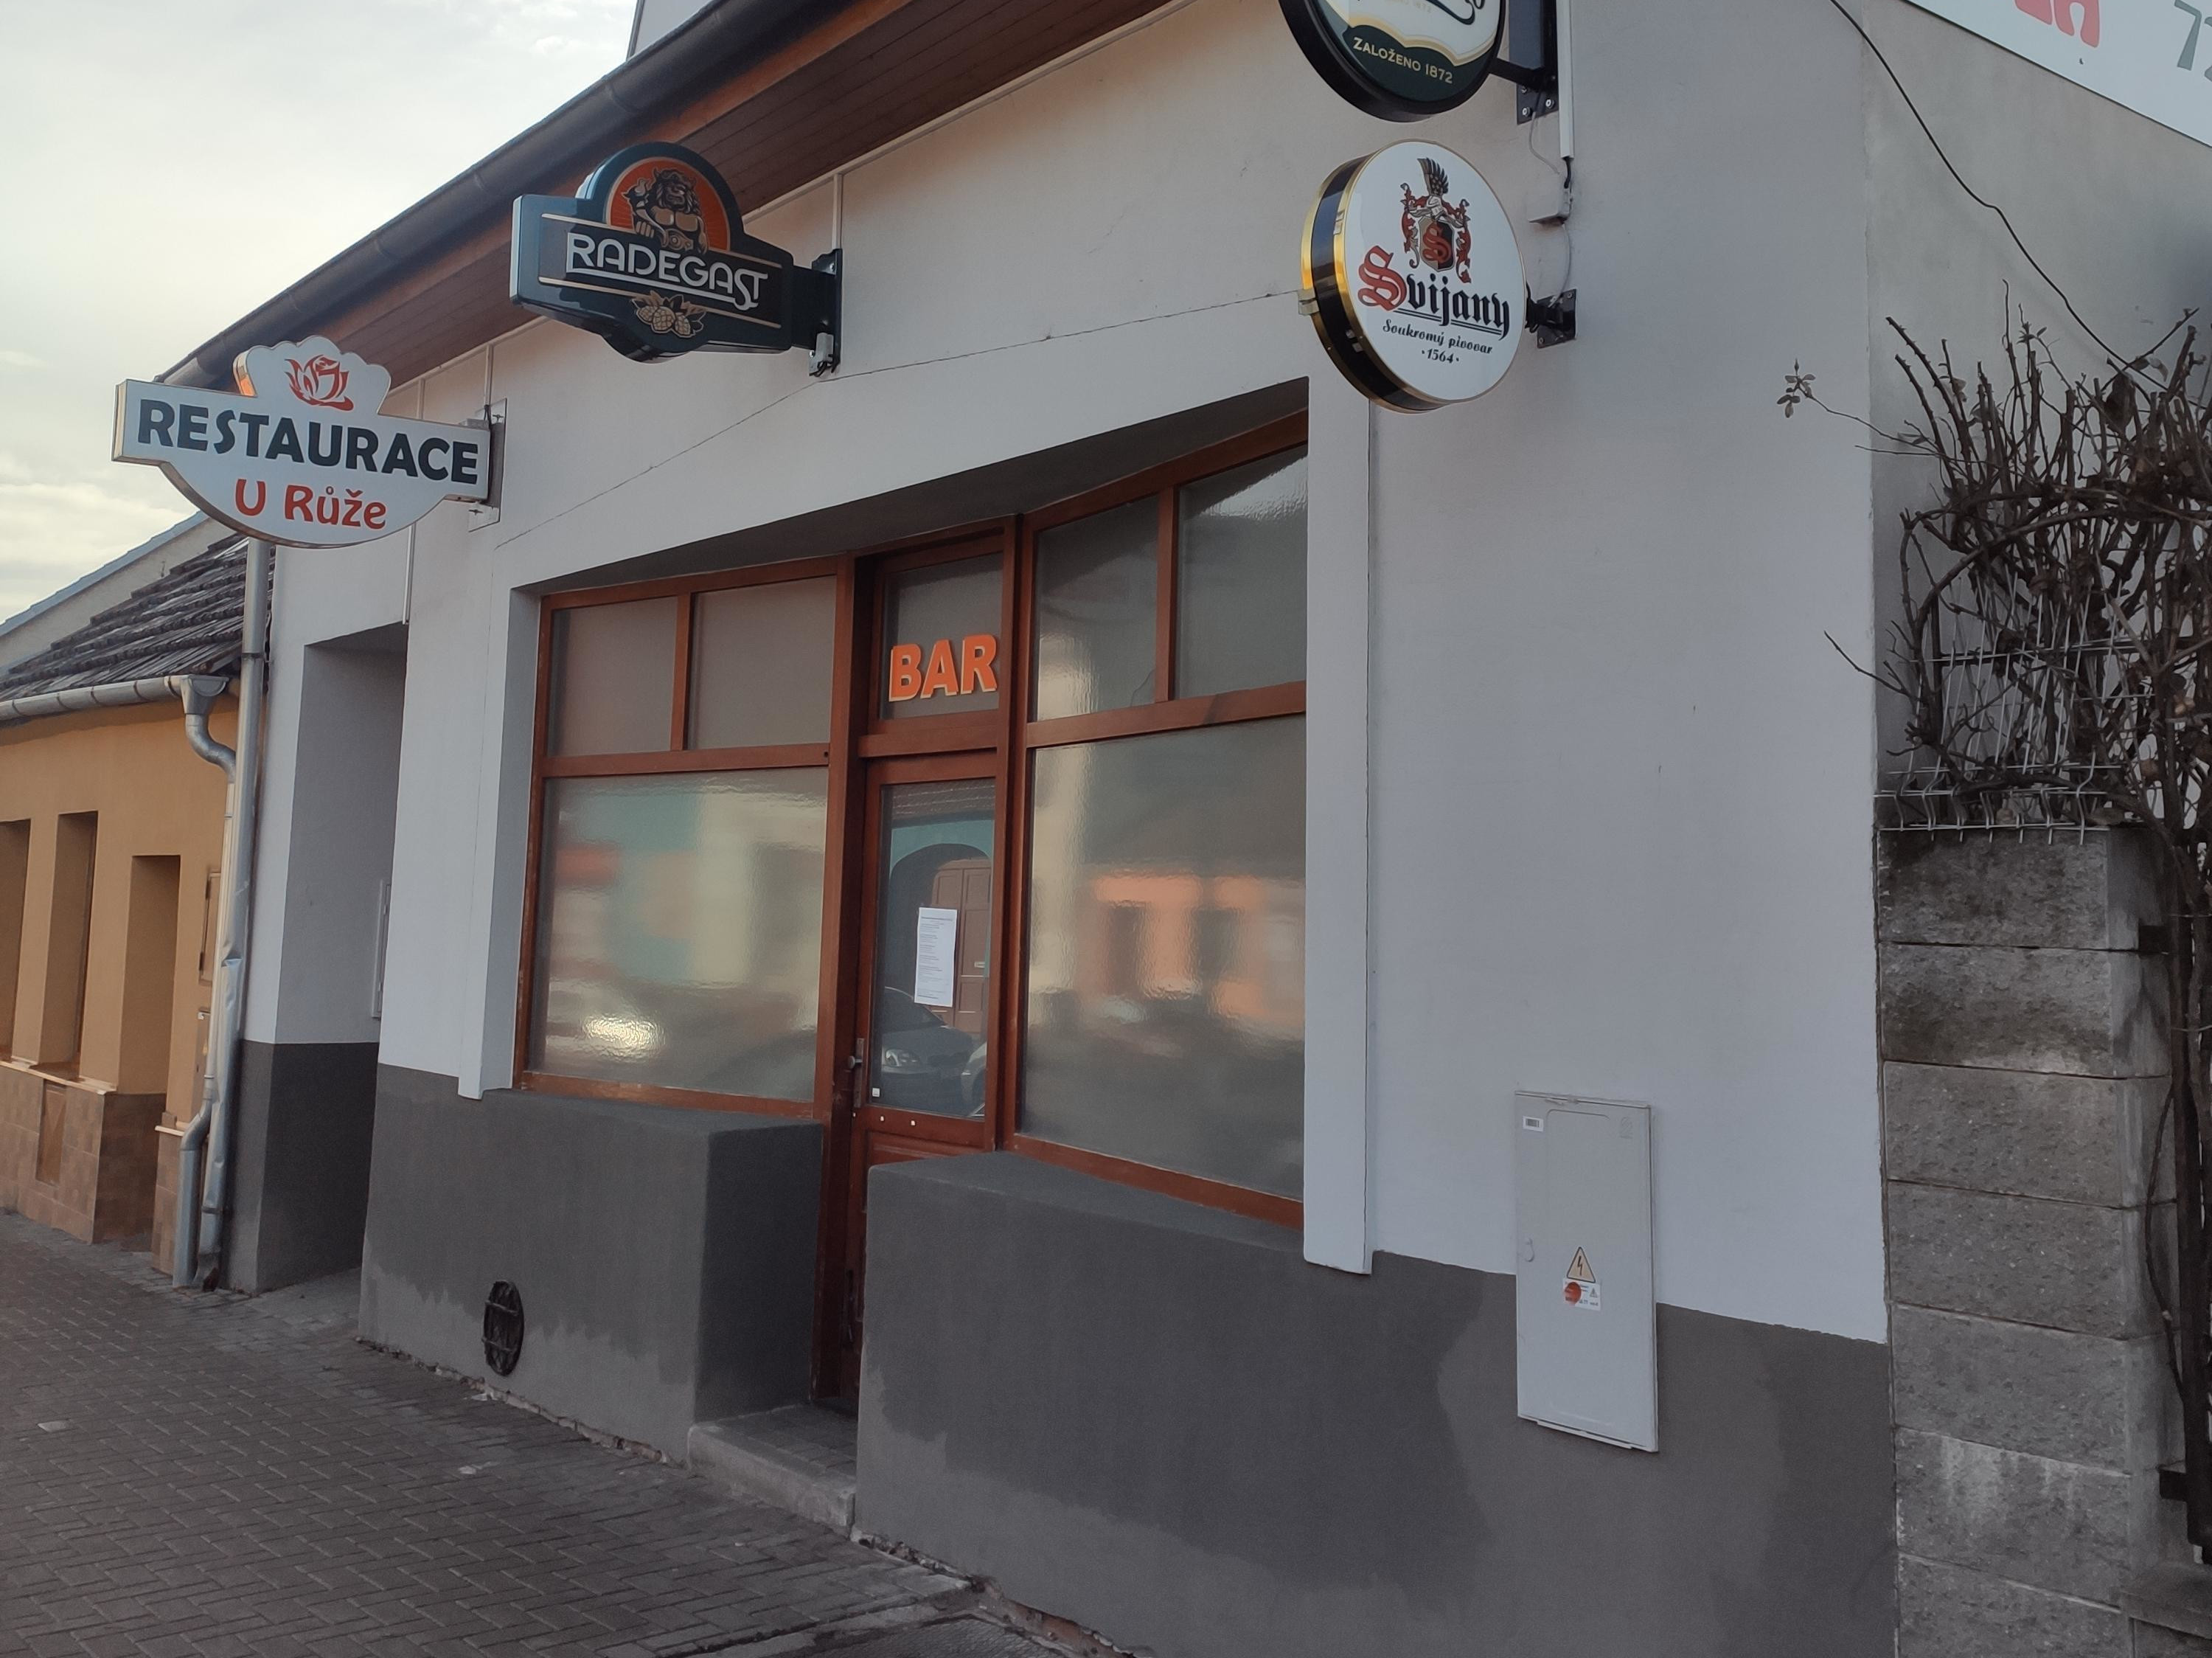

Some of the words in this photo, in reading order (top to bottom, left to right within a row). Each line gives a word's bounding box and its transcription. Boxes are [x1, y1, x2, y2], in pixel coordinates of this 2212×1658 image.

[1353, 37, 1421, 72] ZALOŽENO
[1425, 63, 1453, 84] 1872
[566, 232, 768, 311] RADEGAST
[1357, 245, 1509, 341] Svijany
[1382, 319, 1444, 346] Soukromý
[1448, 336, 1493, 354] pivovar
[137, 398, 479, 485] RESTAURACE
[235, 478, 266, 516] U
[284, 484, 386, 530] Růže
[888, 634, 998, 702] BAR
